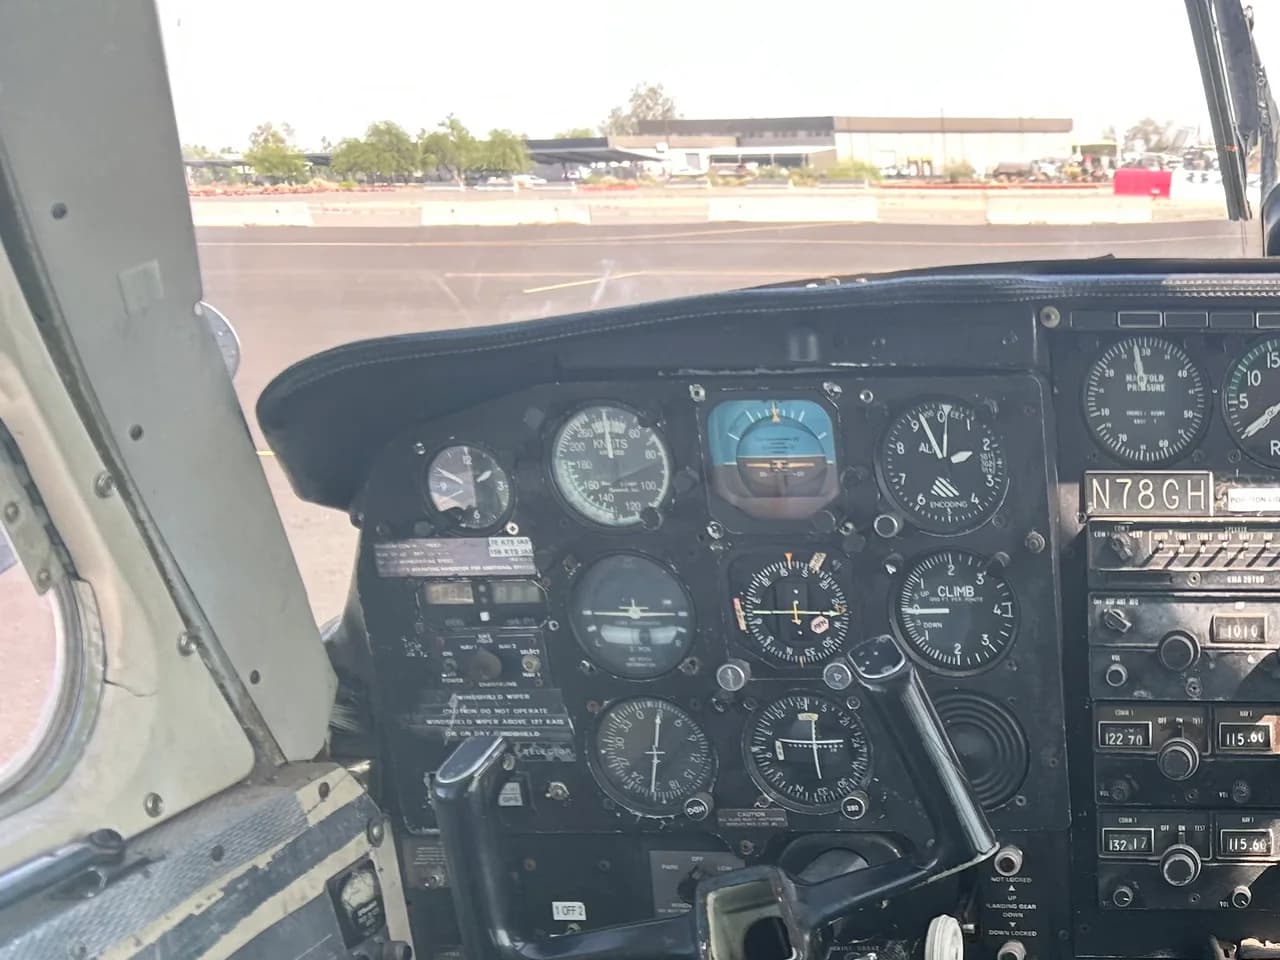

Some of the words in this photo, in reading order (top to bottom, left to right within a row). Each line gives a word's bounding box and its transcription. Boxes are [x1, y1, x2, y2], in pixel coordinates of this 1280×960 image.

[1267, 352, 1280, 368] 15
[1177, 370, 1187, 378] 40
[1248, 370, 1261, 386] 10
[1240, 393, 1248, 409] 5
[1101, 408, 1110, 416] 10
[1183, 409, 1193, 418] 50
[910, 420, 919, 432] 9
[966, 418, 970, 431] 1
[1118, 434, 1128, 442] 70
[896, 442, 904, 454] 8
[982, 438, 990, 450] 2
[1158, 440, 1168, 448] 60
[644, 450, 656, 460] 80
[898, 472, 906, 485] 7
[986, 474, 994, 486] 3
[640, 480, 656, 490] 100
[598, 493, 614, 502] 140
[917, 494, 926, 505] 6
[971, 492, 980, 504] 4
[1092, 478, 1204, 510] N78GH
[625, 501, 641, 511] 120
[473, 509, 480, 519] 6
[948, 564, 955, 576] 2
[976, 572, 984, 584] 3
[937, 586, 974, 598] CLIMB
[992, 604, 1002, 615] 4
[981, 634, 989, 645] 3
[786, 646, 794, 656] N
[804, 648, 816, 656] 33
[954, 643, 962, 654] 2
[636, 710, 644, 720] 0
[796, 784, 804, 792] N
[563, 906, 576, 916] OFF
